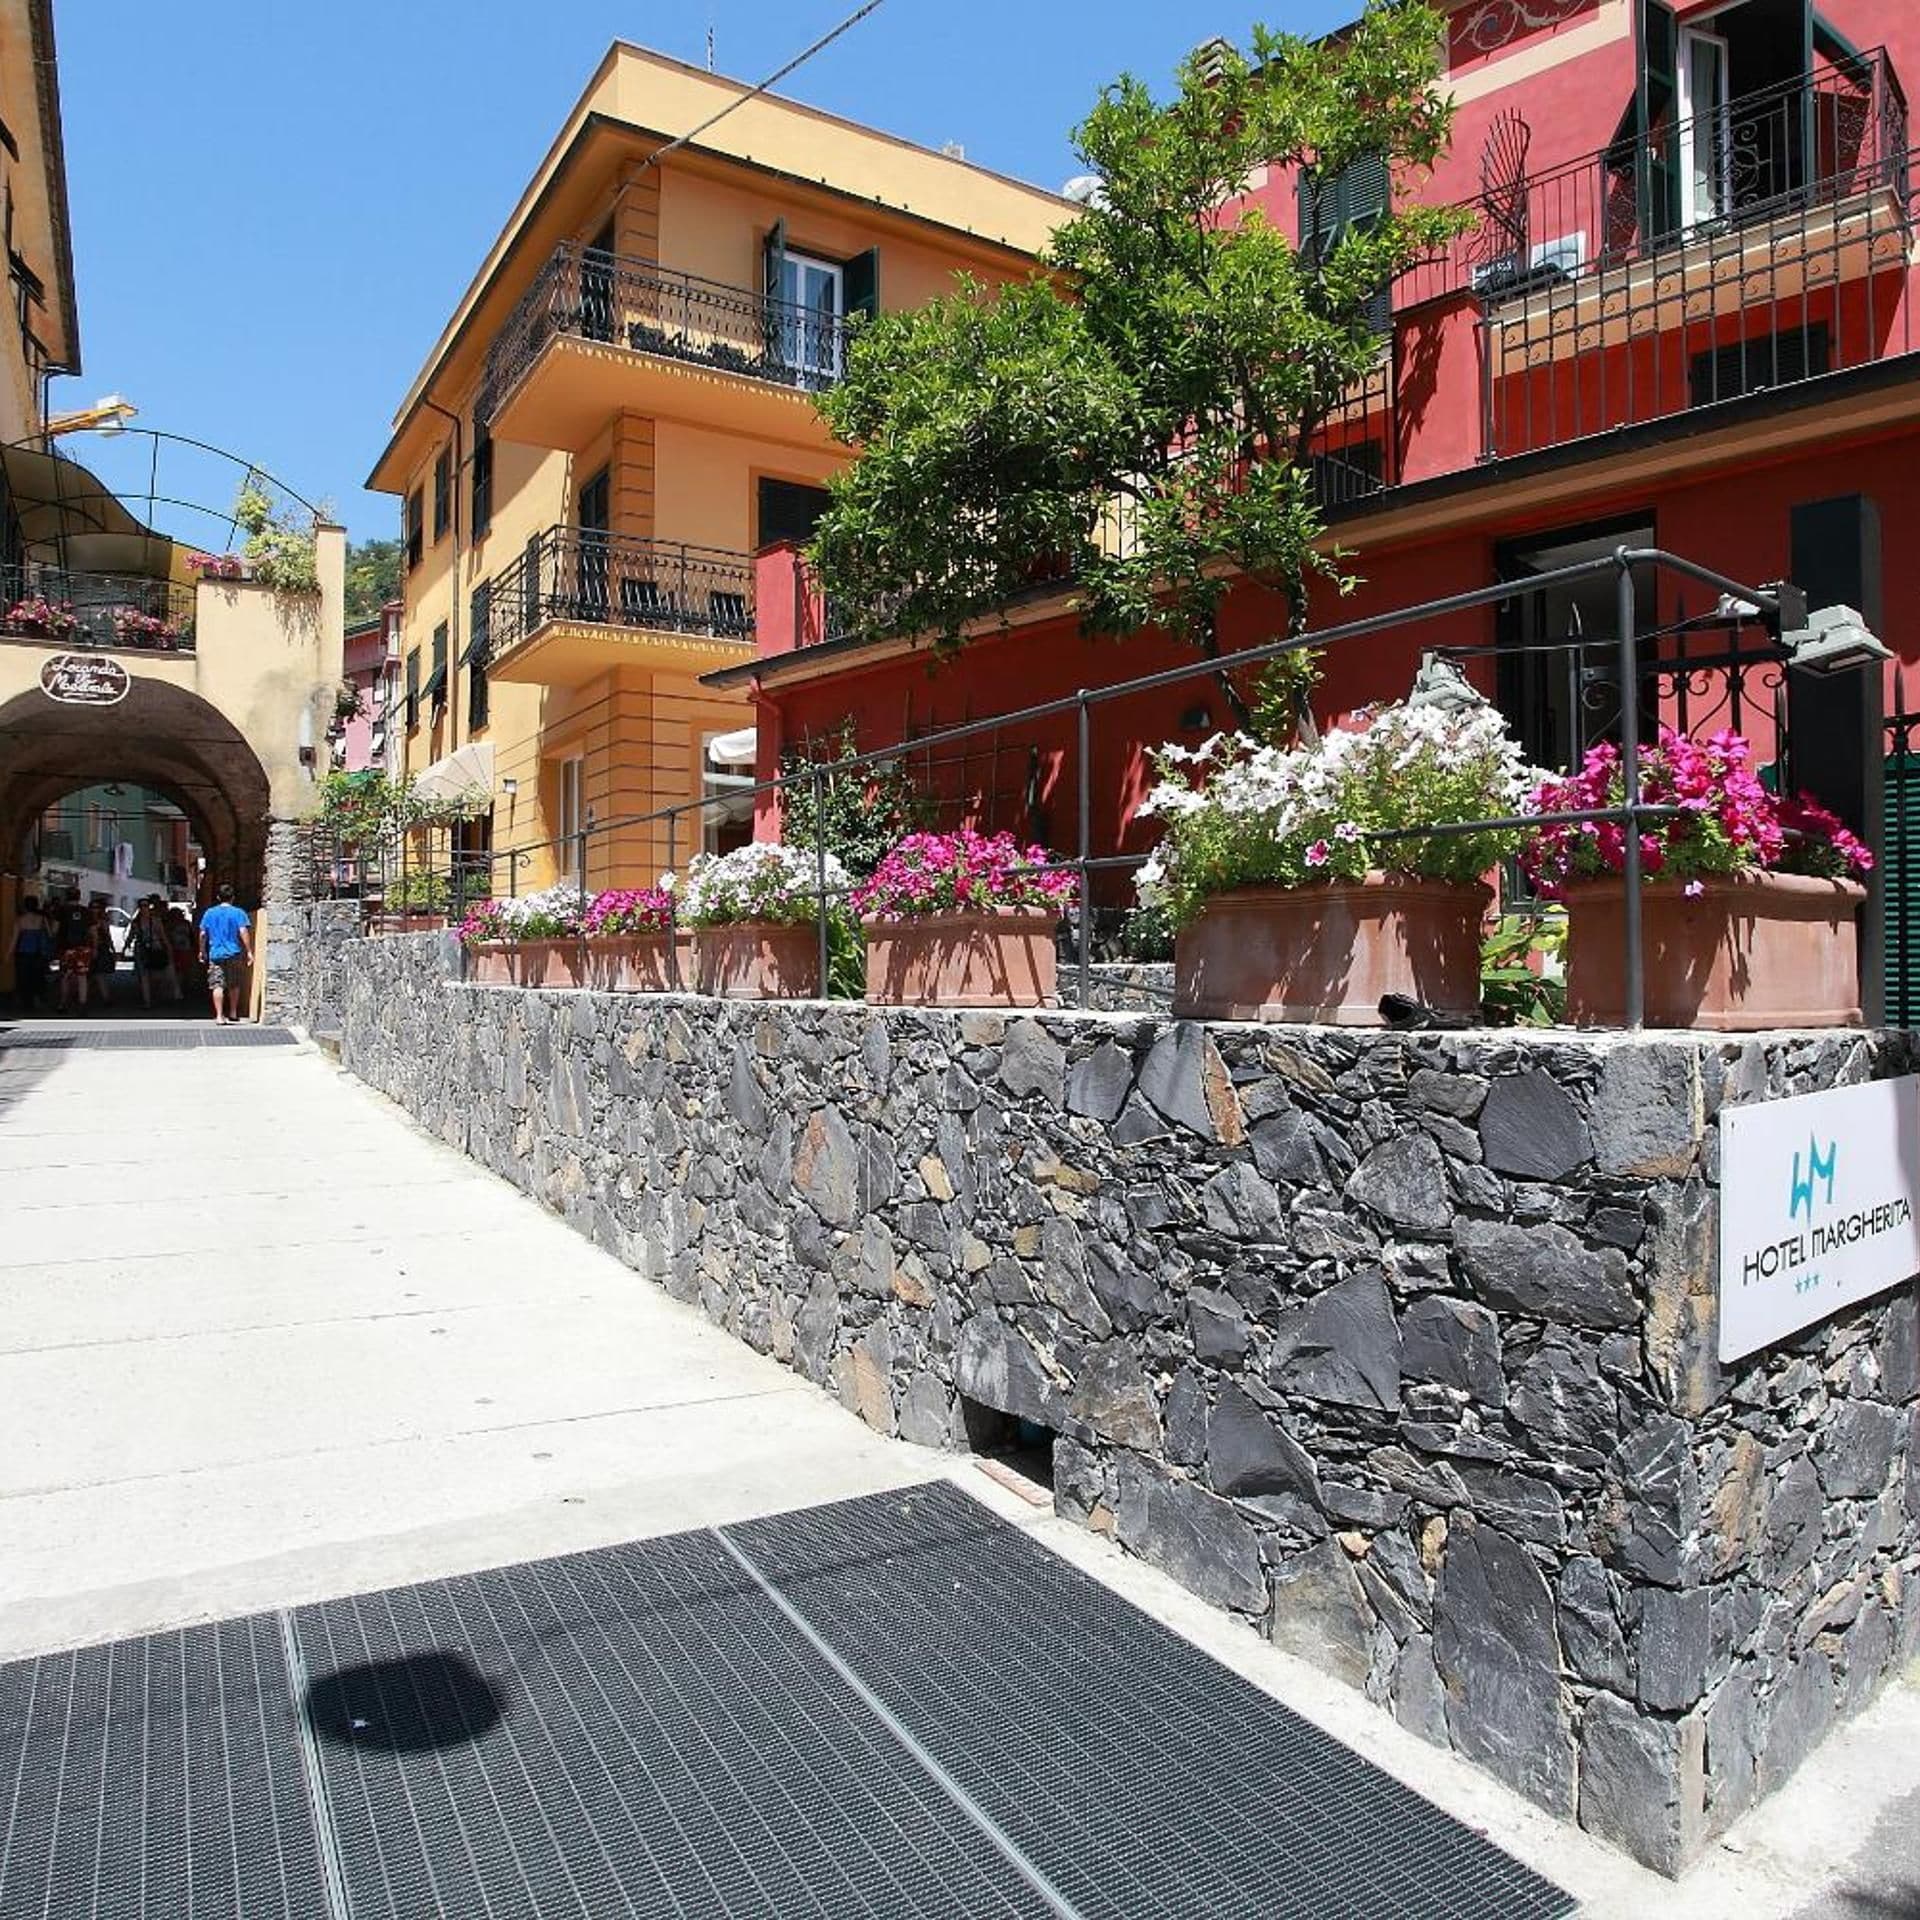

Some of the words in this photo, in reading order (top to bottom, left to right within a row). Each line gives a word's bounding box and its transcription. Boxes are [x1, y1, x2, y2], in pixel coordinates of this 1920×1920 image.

[52, 656, 125, 676] Locanda
[1743, 1234, 1806, 1286] HOTEL
[1811, 1197, 1911, 1258] MARGHERITA
